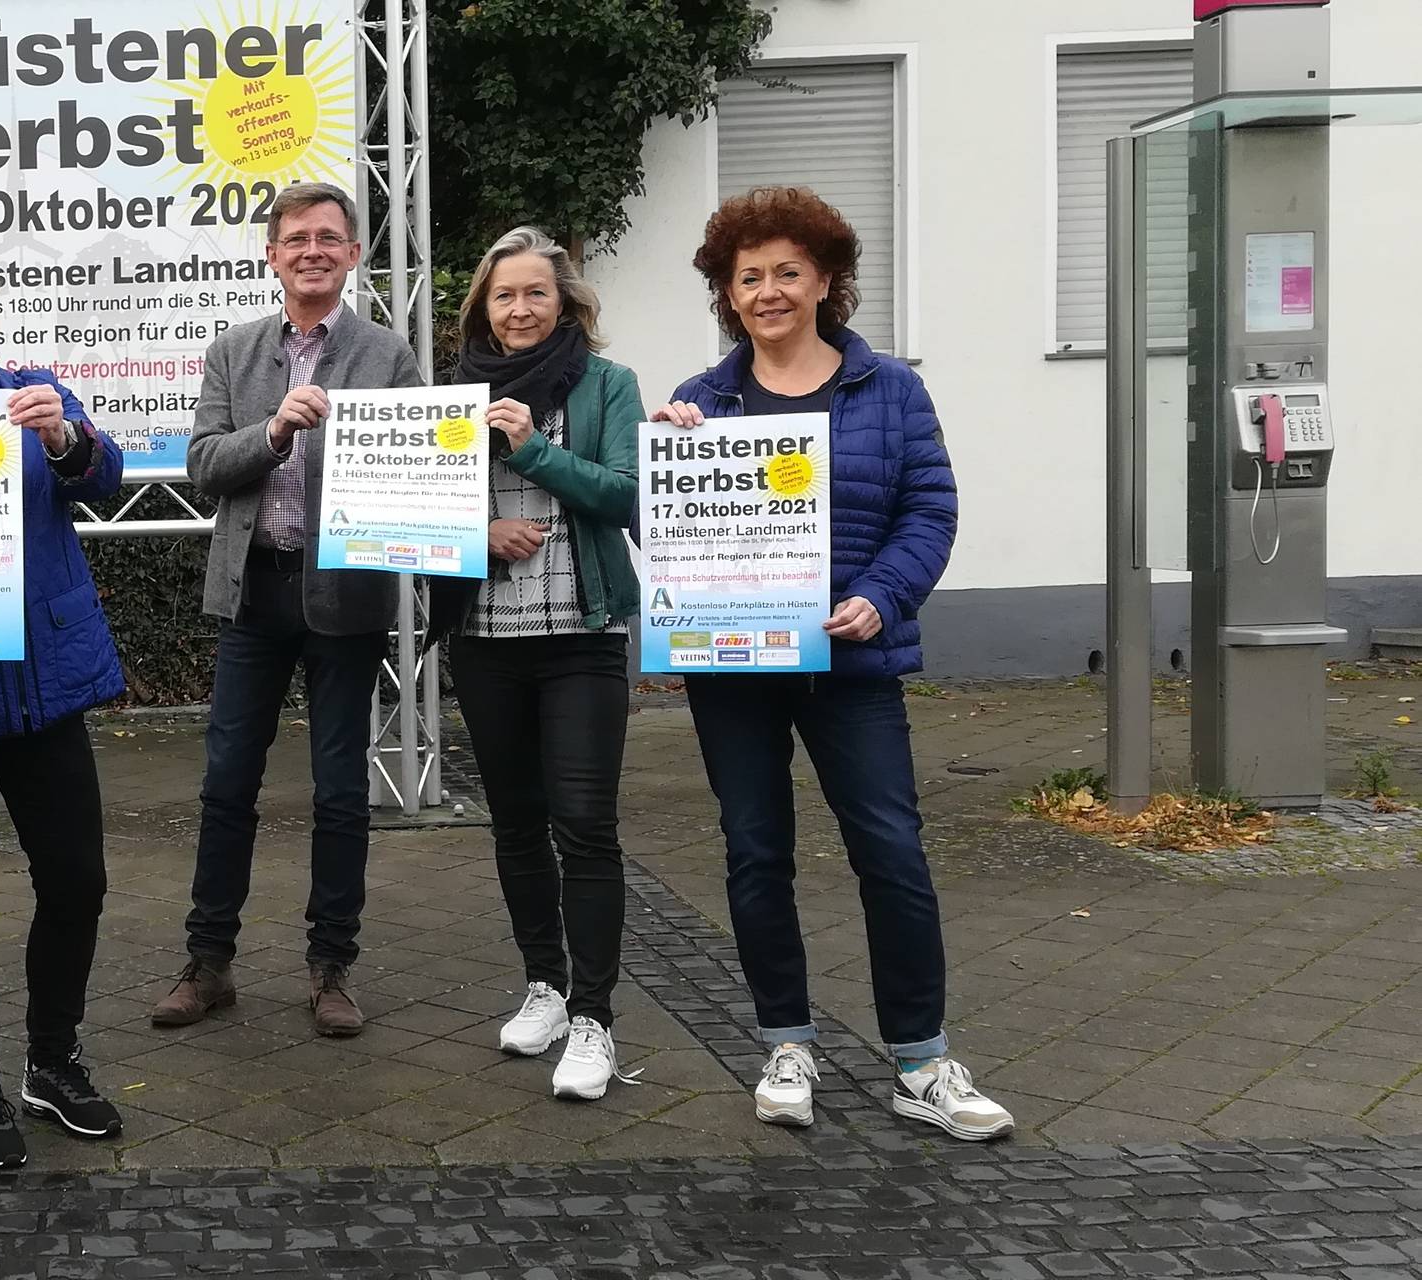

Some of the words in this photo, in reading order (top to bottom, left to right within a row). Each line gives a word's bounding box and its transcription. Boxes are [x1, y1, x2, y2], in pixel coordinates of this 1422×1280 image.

[243, 80, 265, 96] Mit
[226, 93, 290, 118] verkaufs-
[237, 110, 291, 133] offenem
[242, 127, 295, 149] Sonntag
[231, 156, 247, 166] von
[250, 151, 261, 160] 13
[263, 146, 278, 157] bis
[280, 141, 291, 151] 18
[293, 135, 313, 147] Uhr
[190, 180, 302, 226] 202
[113, 254, 281, 285] Landmar
[9, 297, 53, 313] 18:00
[57, 296, 87, 312] Uhr
[92, 294, 131, 311] rund
[136, 296, 163, 310] um
[169, 292, 193, 309] die
[198, 292, 221, 308] St.
[226, 290, 266, 307] Petri
[13, 325, 47, 345] der
[54, 323, 132, 347] Region
[137, 322, 168, 341] für
[174, 320, 207, 339] die
[93, 393, 199, 416] Parkplätz
[337, 402, 476, 422] Hüstener
[126, 427, 149, 438] und
[335, 428, 437, 447] Herbst
[335, 454, 359, 465] 17.
[364, 453, 431, 466] Oktober
[436, 454, 478, 466] 2021
[650, 436, 814, 462] Hüstener
[332, 470, 342, 478] 8.
[346, 470, 403, 480] Hüstener
[408, 471, 477, 481] Landmarkt
[651, 467, 769, 494] Herbst
[651, 504, 679, 519] 17.
[685, 502, 762, 518] Oktober
[768, 498, 817, 515] 2021
[329, 528, 368, 537] VGH
[650, 527, 662, 538] 8.
[665, 525, 731, 538] Hüstener
[736, 522, 817, 536] Landmarkt
[651, 616, 695, 627] VGH
[680, 653, 711, 662] VELTINS
